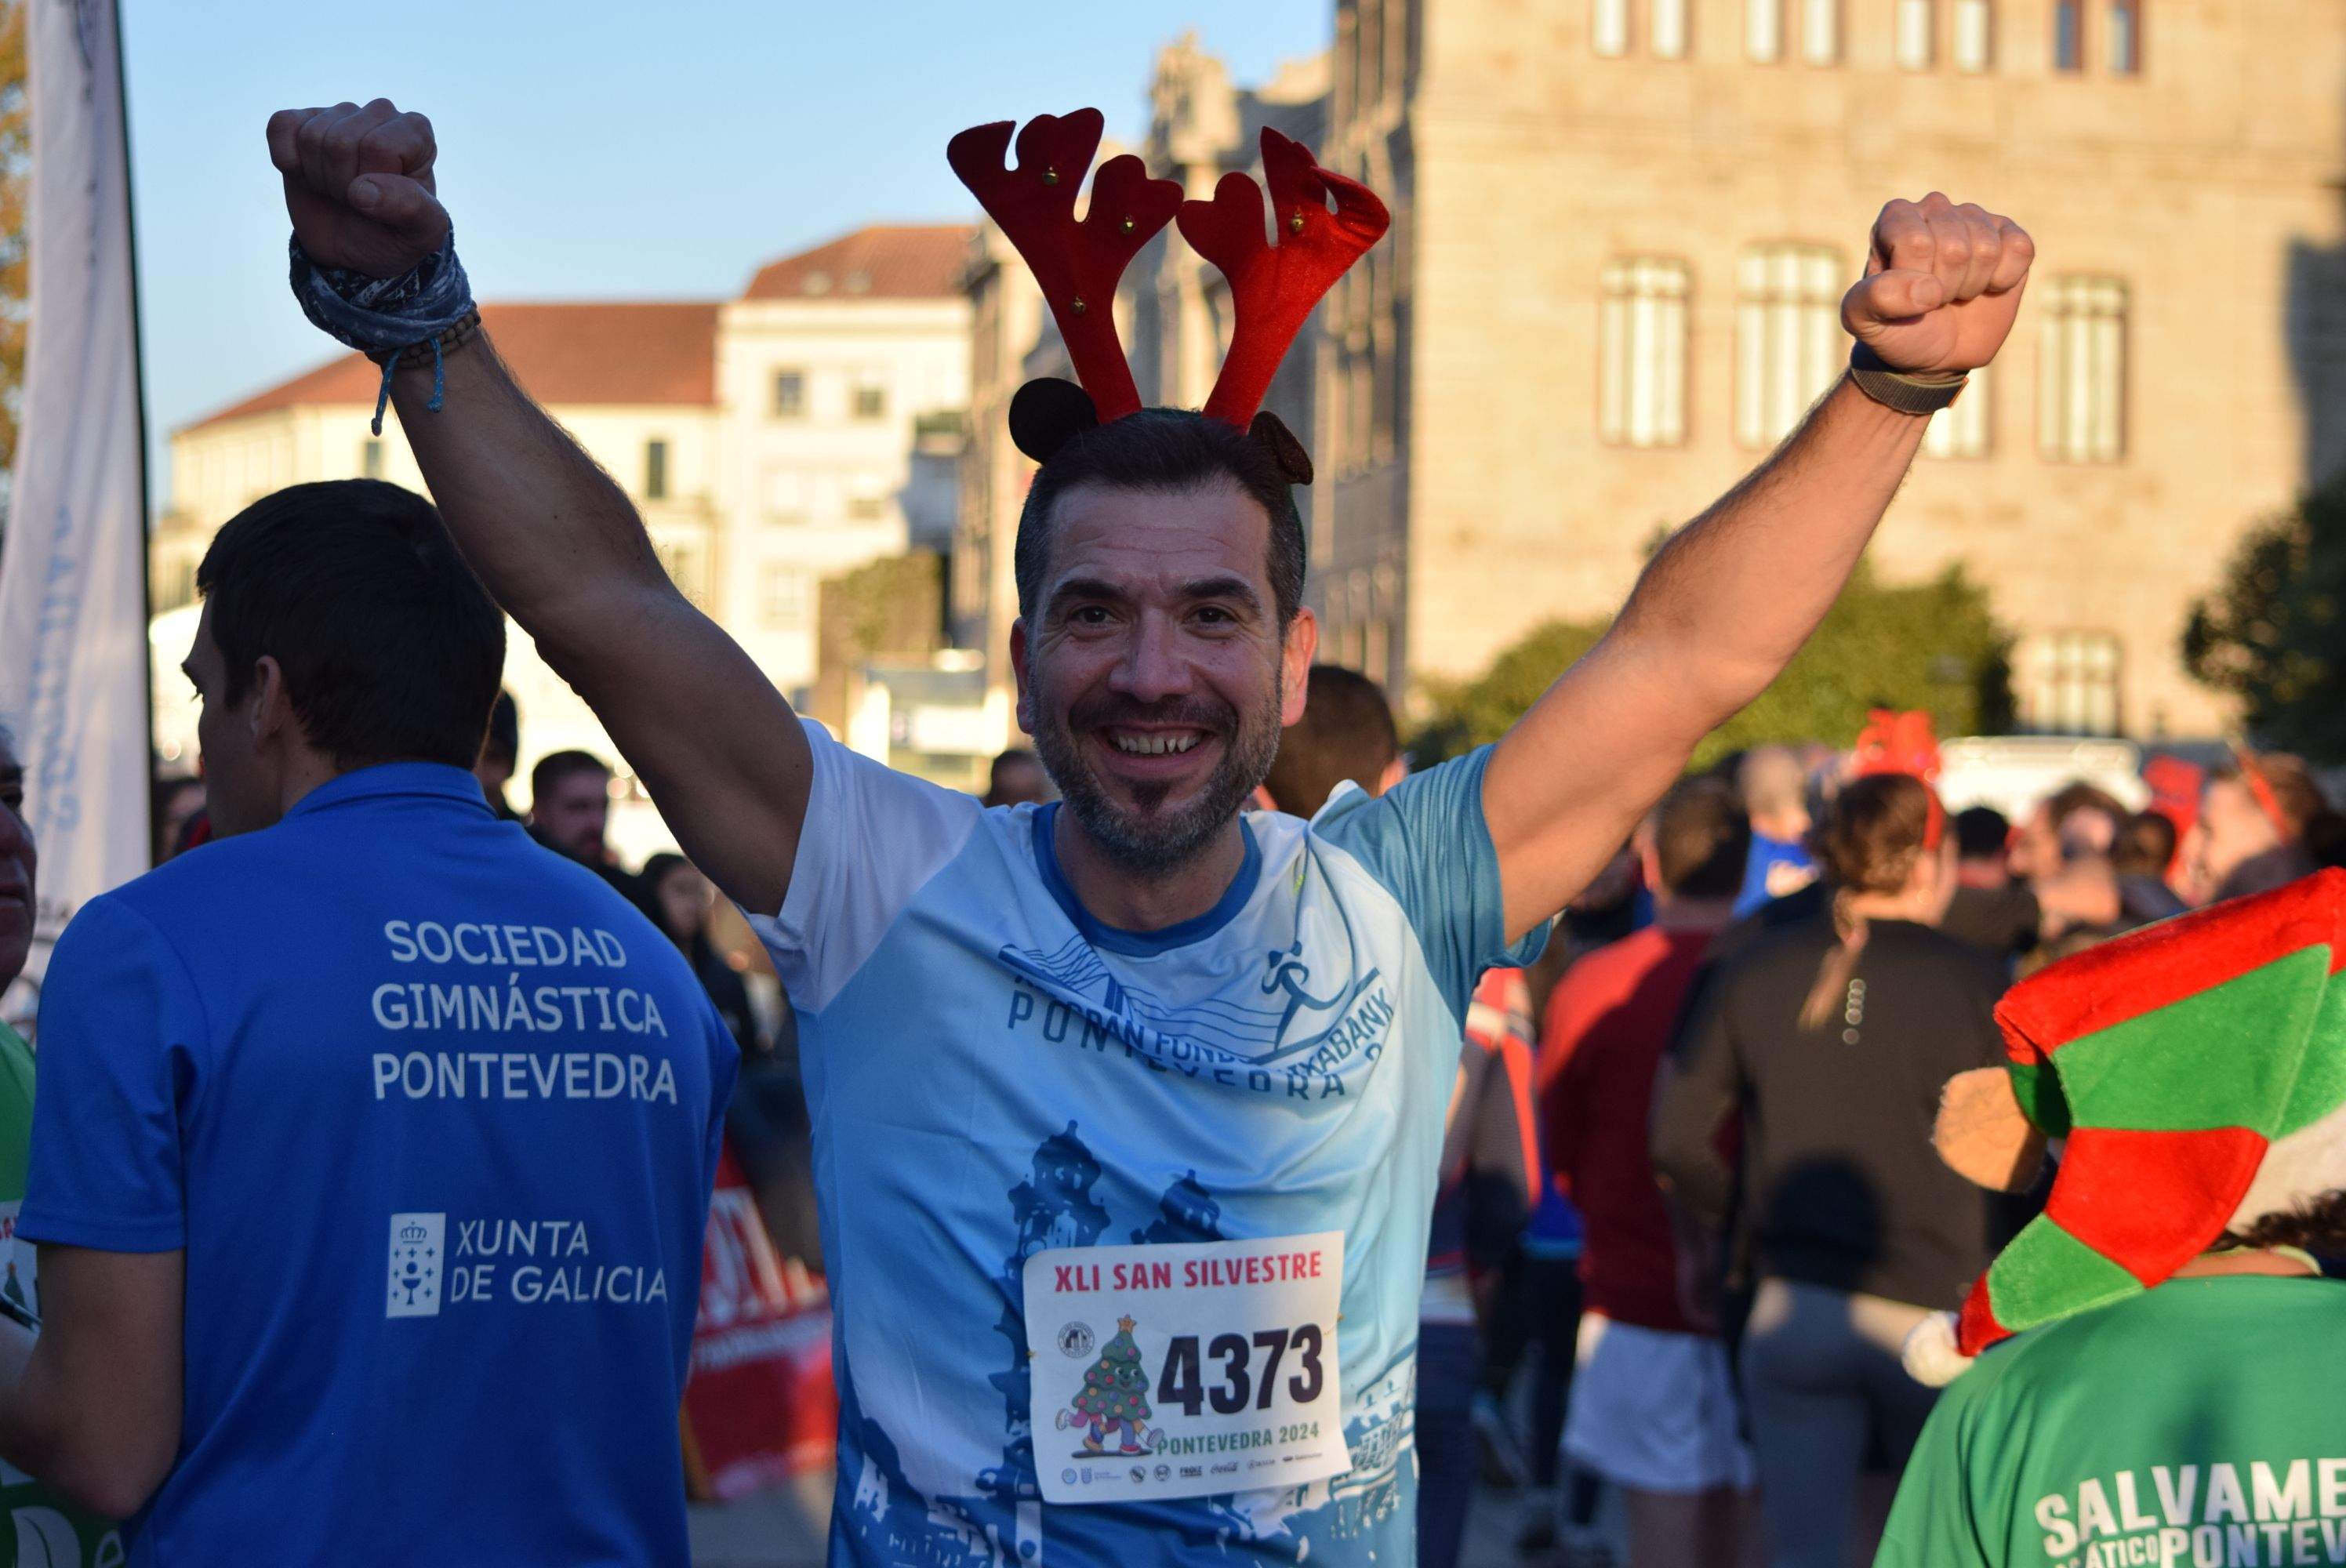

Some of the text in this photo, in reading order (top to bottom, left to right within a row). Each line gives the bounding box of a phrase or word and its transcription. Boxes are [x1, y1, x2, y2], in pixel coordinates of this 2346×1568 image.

[384, 920, 626, 967] SOCIEDAD
[372, 972, 666, 1036] GIMNÁSTICA
[373, 1051, 676, 1104] PONTEVEDRA
[456, 1220, 590, 1257] XUNTA
[451, 1266, 667, 1303] DE GALICIA
[1055, 1250, 1323, 1292] XLI SAN SILVESTRE
[1157, 1323, 1323, 1416] 4373
[1157, 1421, 1320, 1455] PONTEVEDRA 2024
